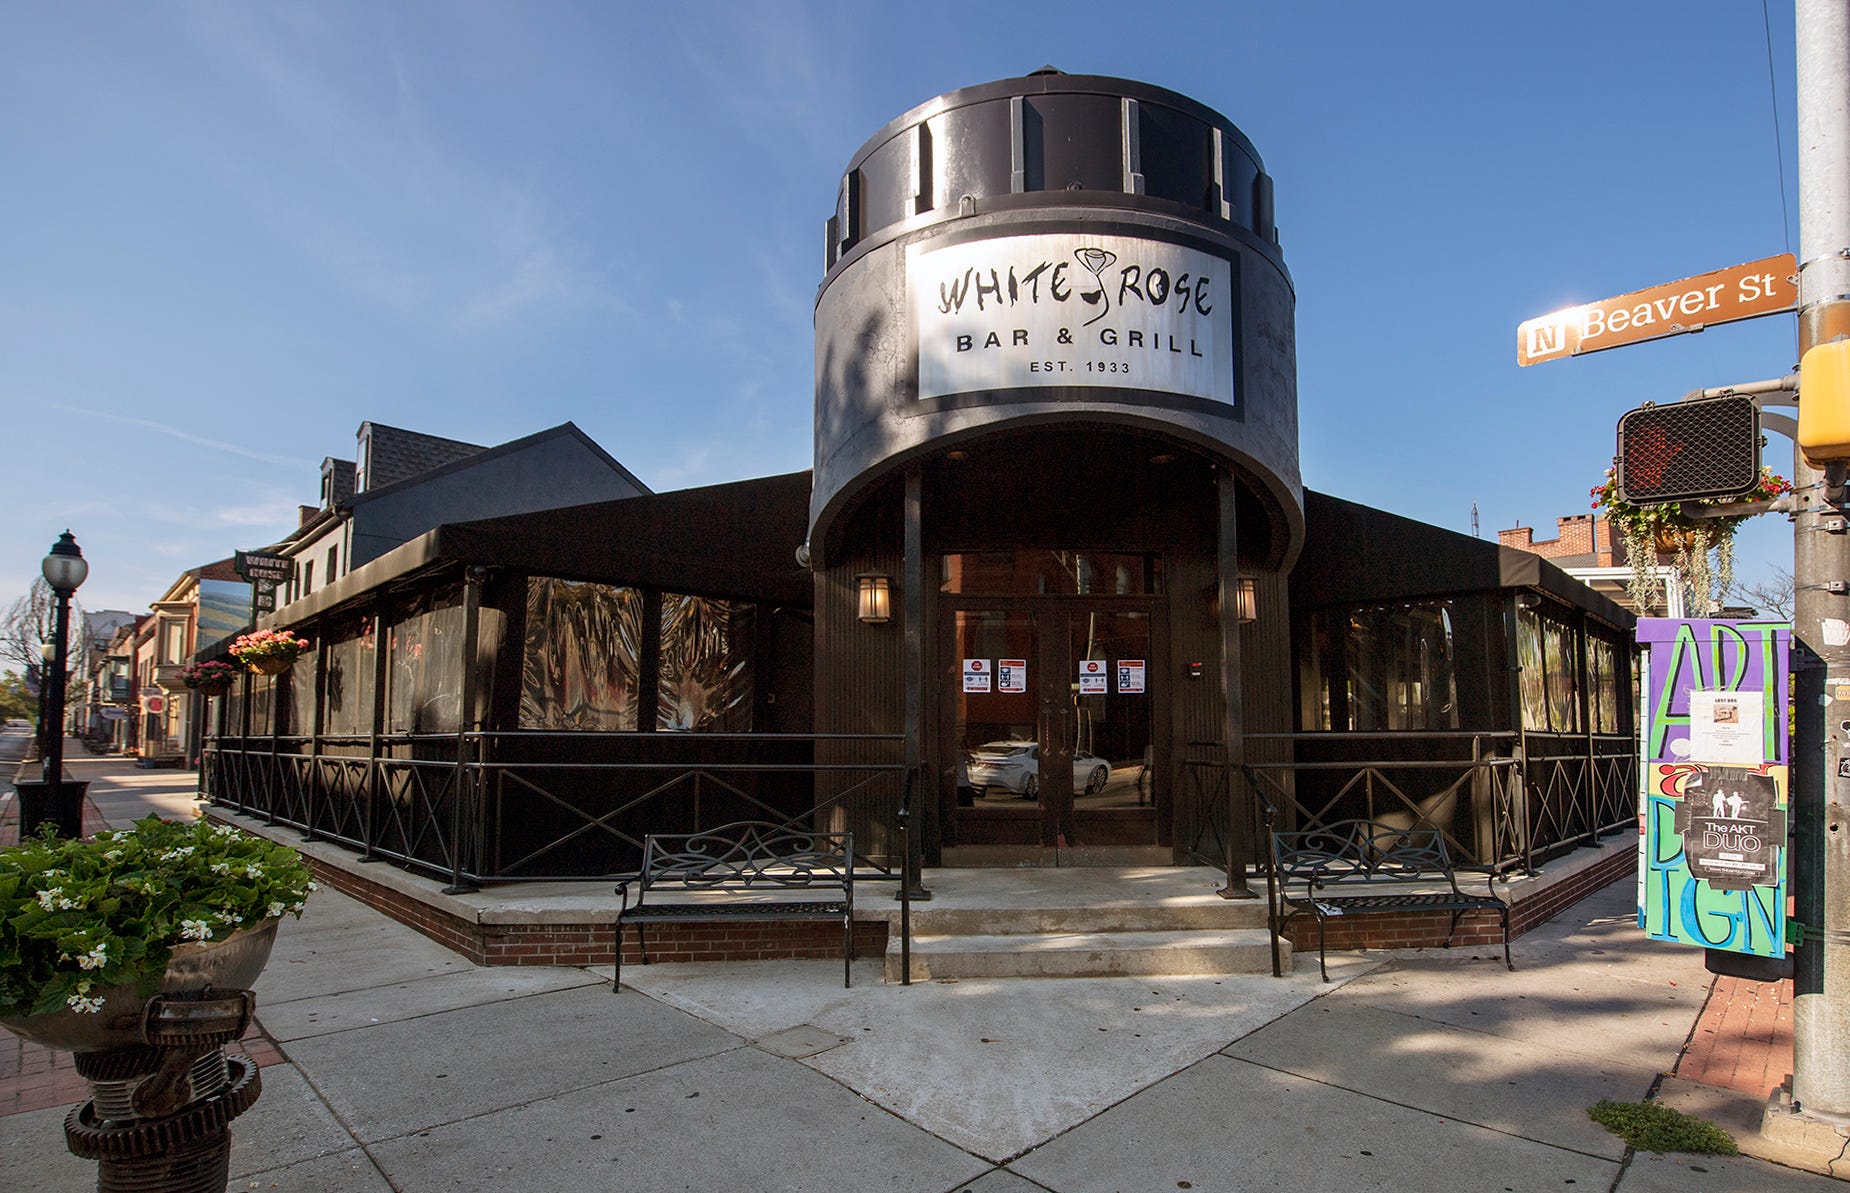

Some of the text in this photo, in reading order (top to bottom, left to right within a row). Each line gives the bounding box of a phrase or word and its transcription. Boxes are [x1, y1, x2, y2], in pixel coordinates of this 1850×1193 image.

[938, 261, 1212, 316] WHITE ROSE
[1532, 272, 1777, 353] N Beaver St
[956, 327, 1203, 357] BAR & GRILL
[1030, 361, 1130, 374] EST. 1933
[1704, 822, 1757, 834] The AKT
[1703, 831, 1762, 853] DUO
